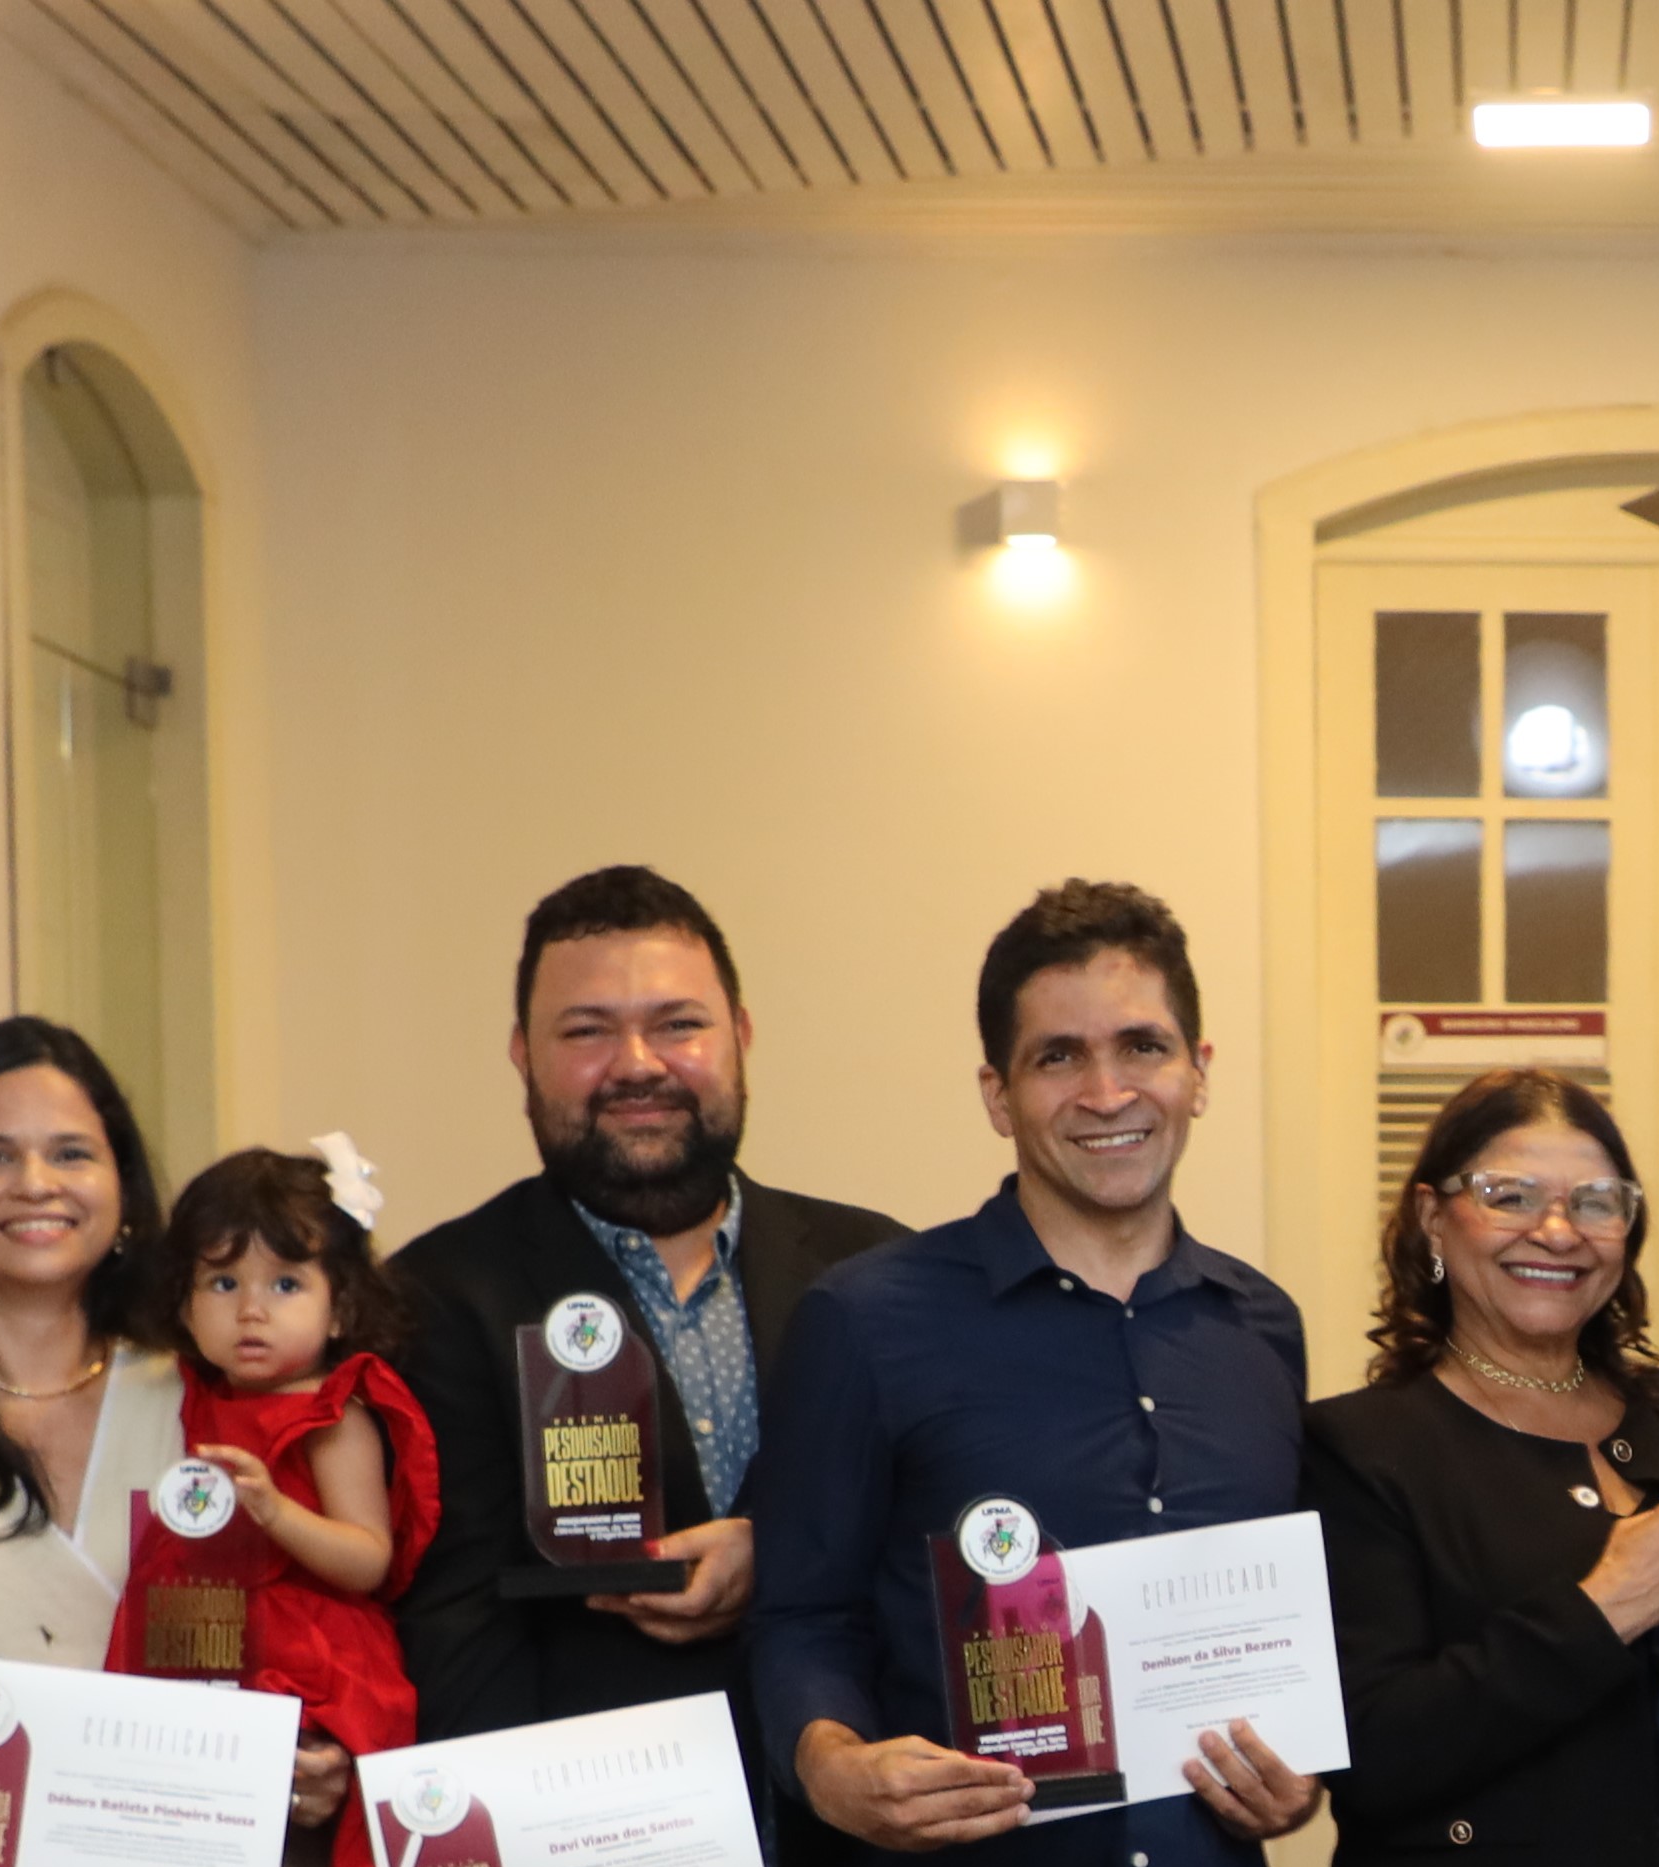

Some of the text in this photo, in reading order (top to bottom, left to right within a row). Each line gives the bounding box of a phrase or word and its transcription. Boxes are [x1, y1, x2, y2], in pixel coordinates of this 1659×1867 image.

[544, 1423, 640, 1461] PESQUISADOR
[546, 1457, 644, 1508] DESTAQUE
[981, 1506, 1012, 1516] UFMA
[1142, 1562, 1278, 1610] CERTIFICADO
[1141, 1637, 1292, 1672] Denilson da Silva Bezerra
[968, 1665, 1070, 1724] DESTAQUE
[548, 1817, 694, 1856] Davi Viana dos Santos
